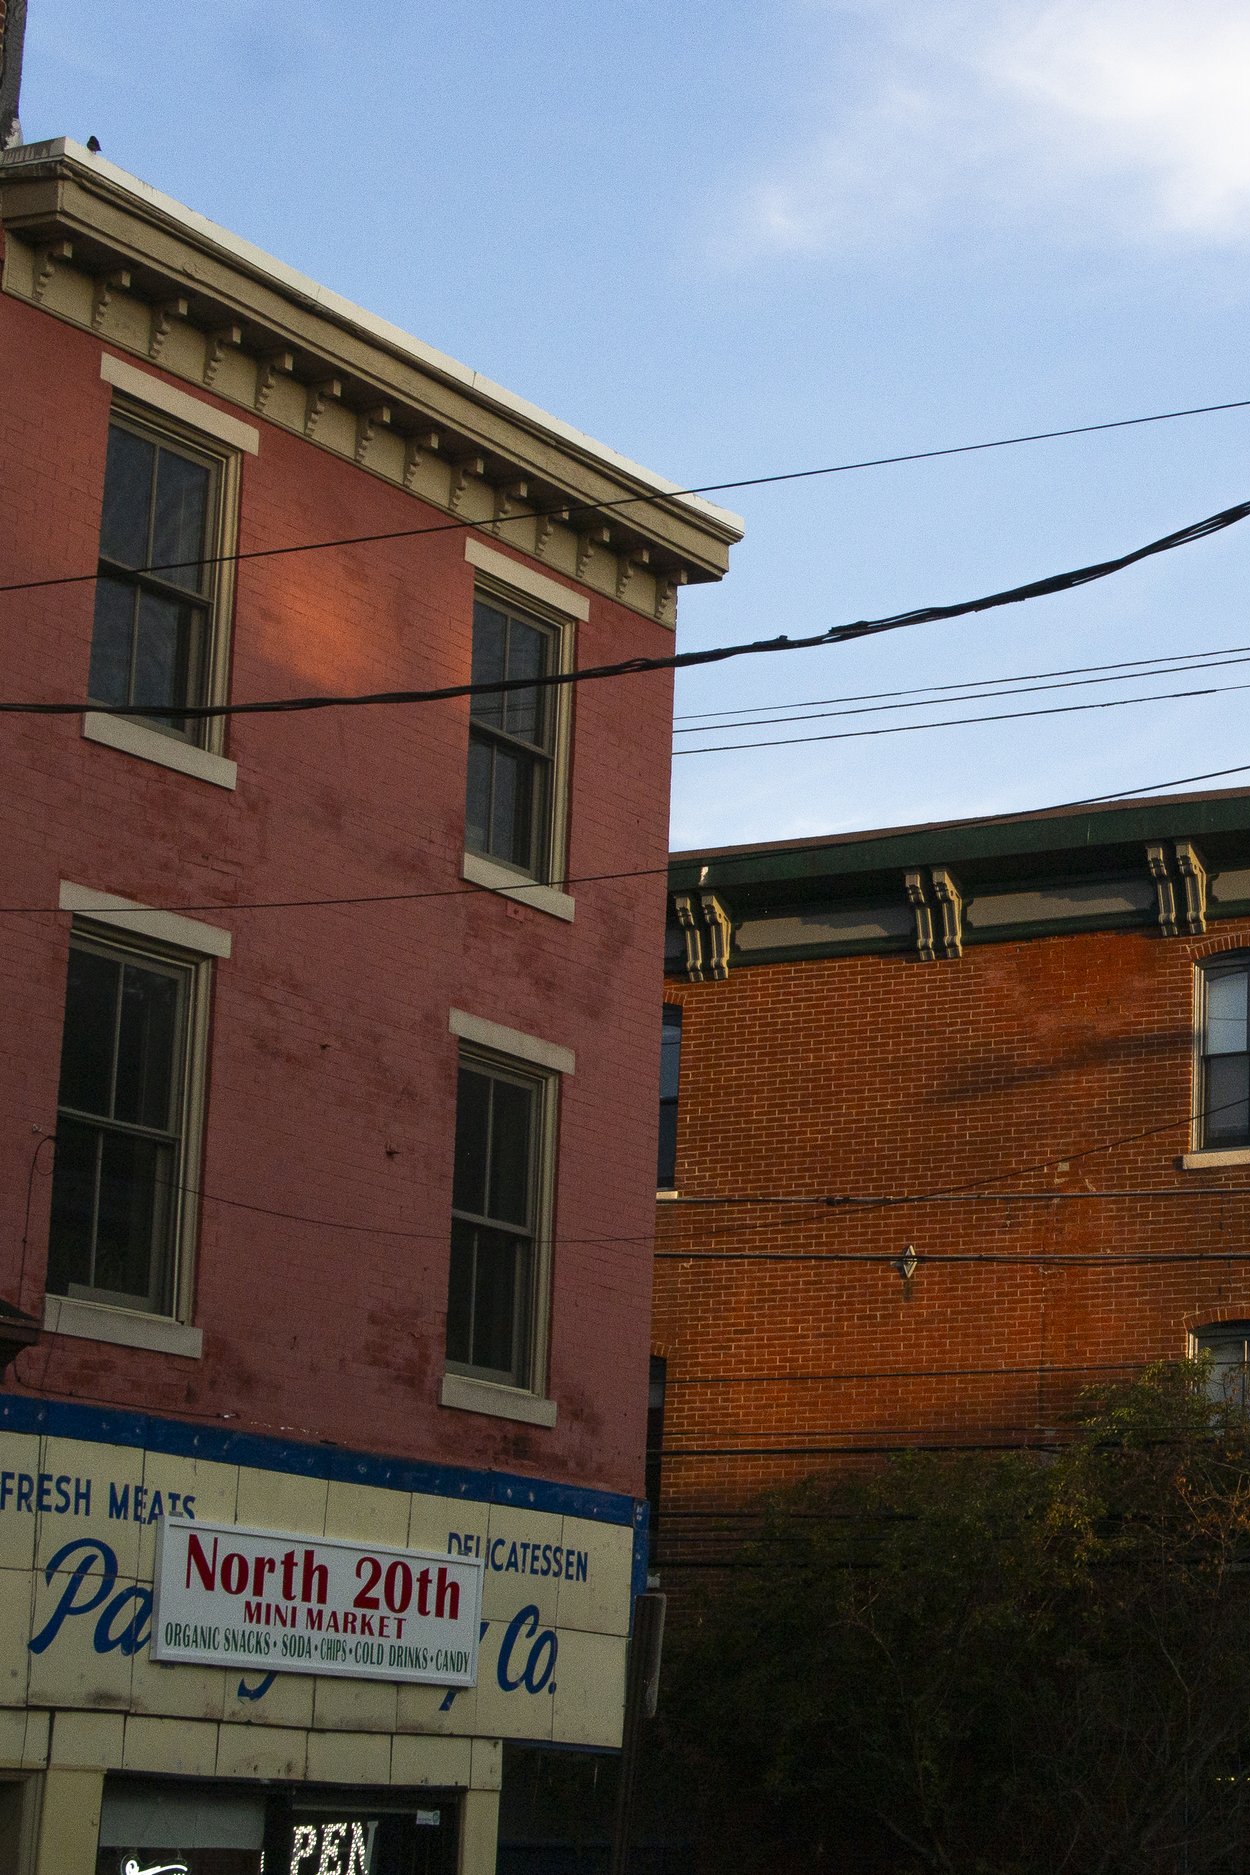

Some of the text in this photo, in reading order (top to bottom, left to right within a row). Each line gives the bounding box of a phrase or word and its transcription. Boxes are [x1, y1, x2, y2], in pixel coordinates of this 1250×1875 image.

[0, 1471, 197, 1525] FRESH MEATS
[185, 1534, 329, 1604] North
[353, 1556, 461, 1620] 20th
[243, 1600, 407, 1639] MINI MARKET
[164, 1622, 471, 1673] ORGANIC SNACKS SODA CHIPS COLD DRINKS CANDY
[497, 1604, 558, 1695] Co.
[260, 1821, 379, 1875] PEN
